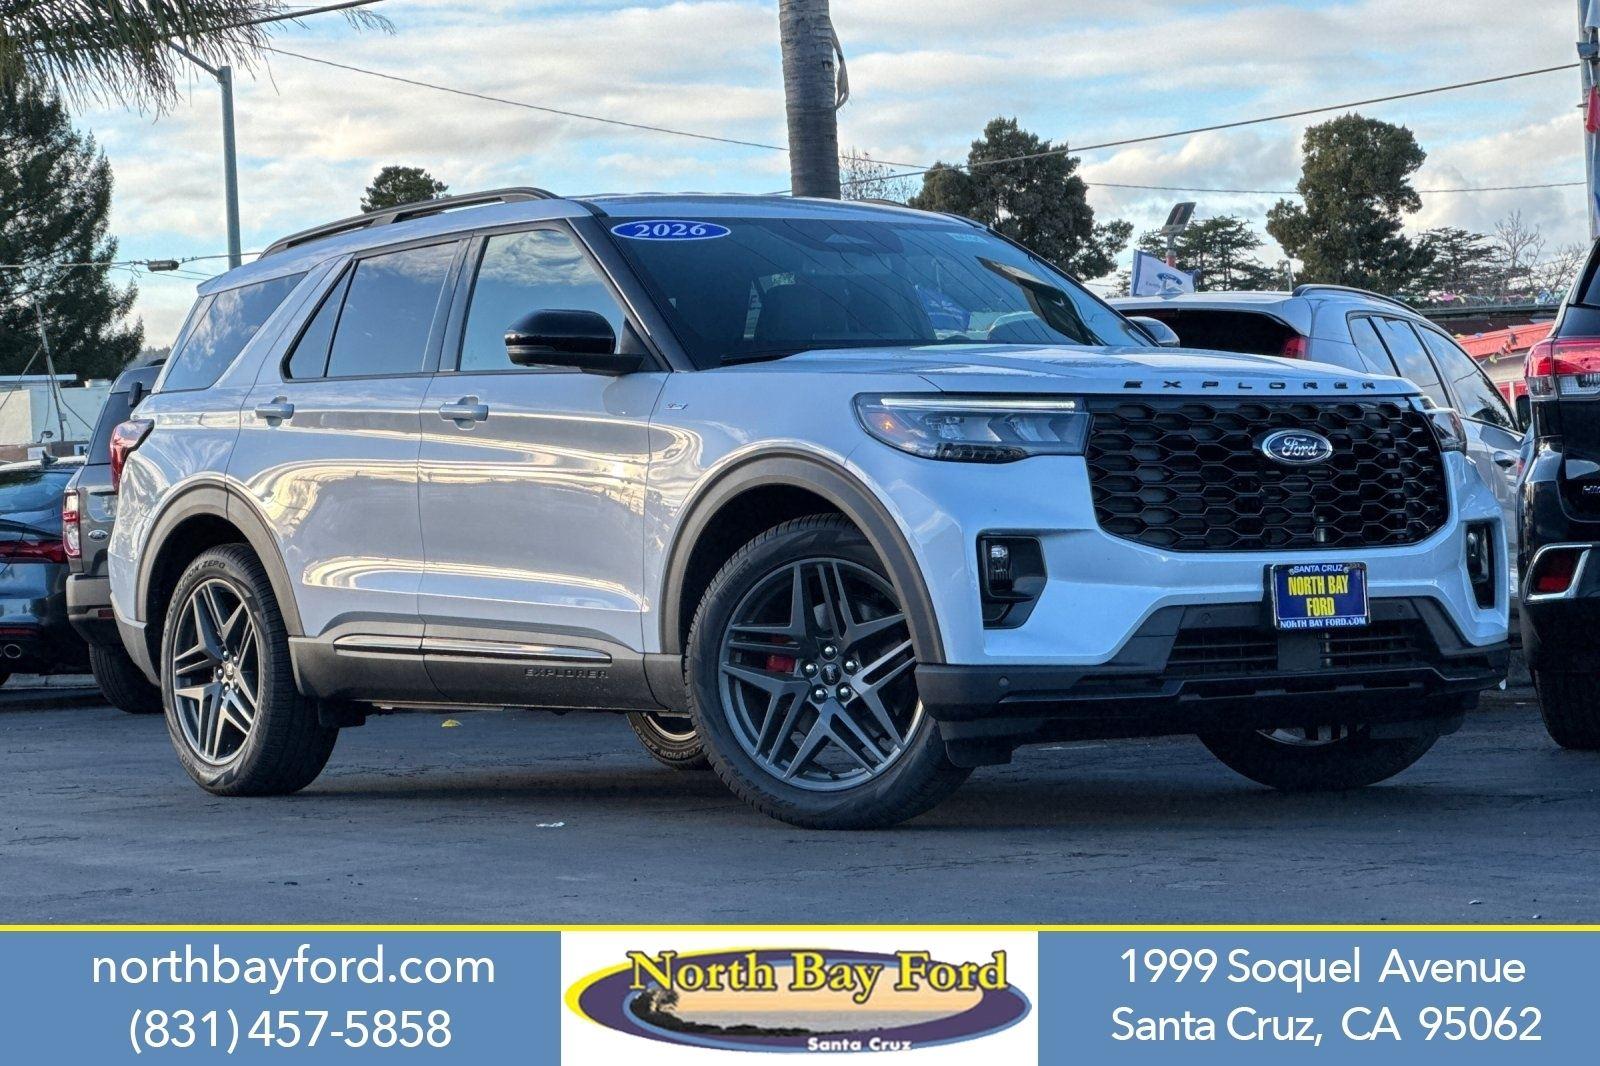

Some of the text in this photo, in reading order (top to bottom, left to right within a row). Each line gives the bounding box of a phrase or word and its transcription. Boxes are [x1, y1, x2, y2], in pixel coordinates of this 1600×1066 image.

[634, 223, 707, 237] 2026
[1123, 380, 1376, 390] EXPLORER
[1281, 436, 1319, 457] Ford
[1293, 564, 1343, 573] SANTA CRUZ
[1288, 575, 1349, 595] NORTH BAY
[1306, 596, 1335, 617] FORD
[1280, 617, 1365, 628] NORTH BAY FORD.COM
[525, 668, 609, 679] EXPLORER
